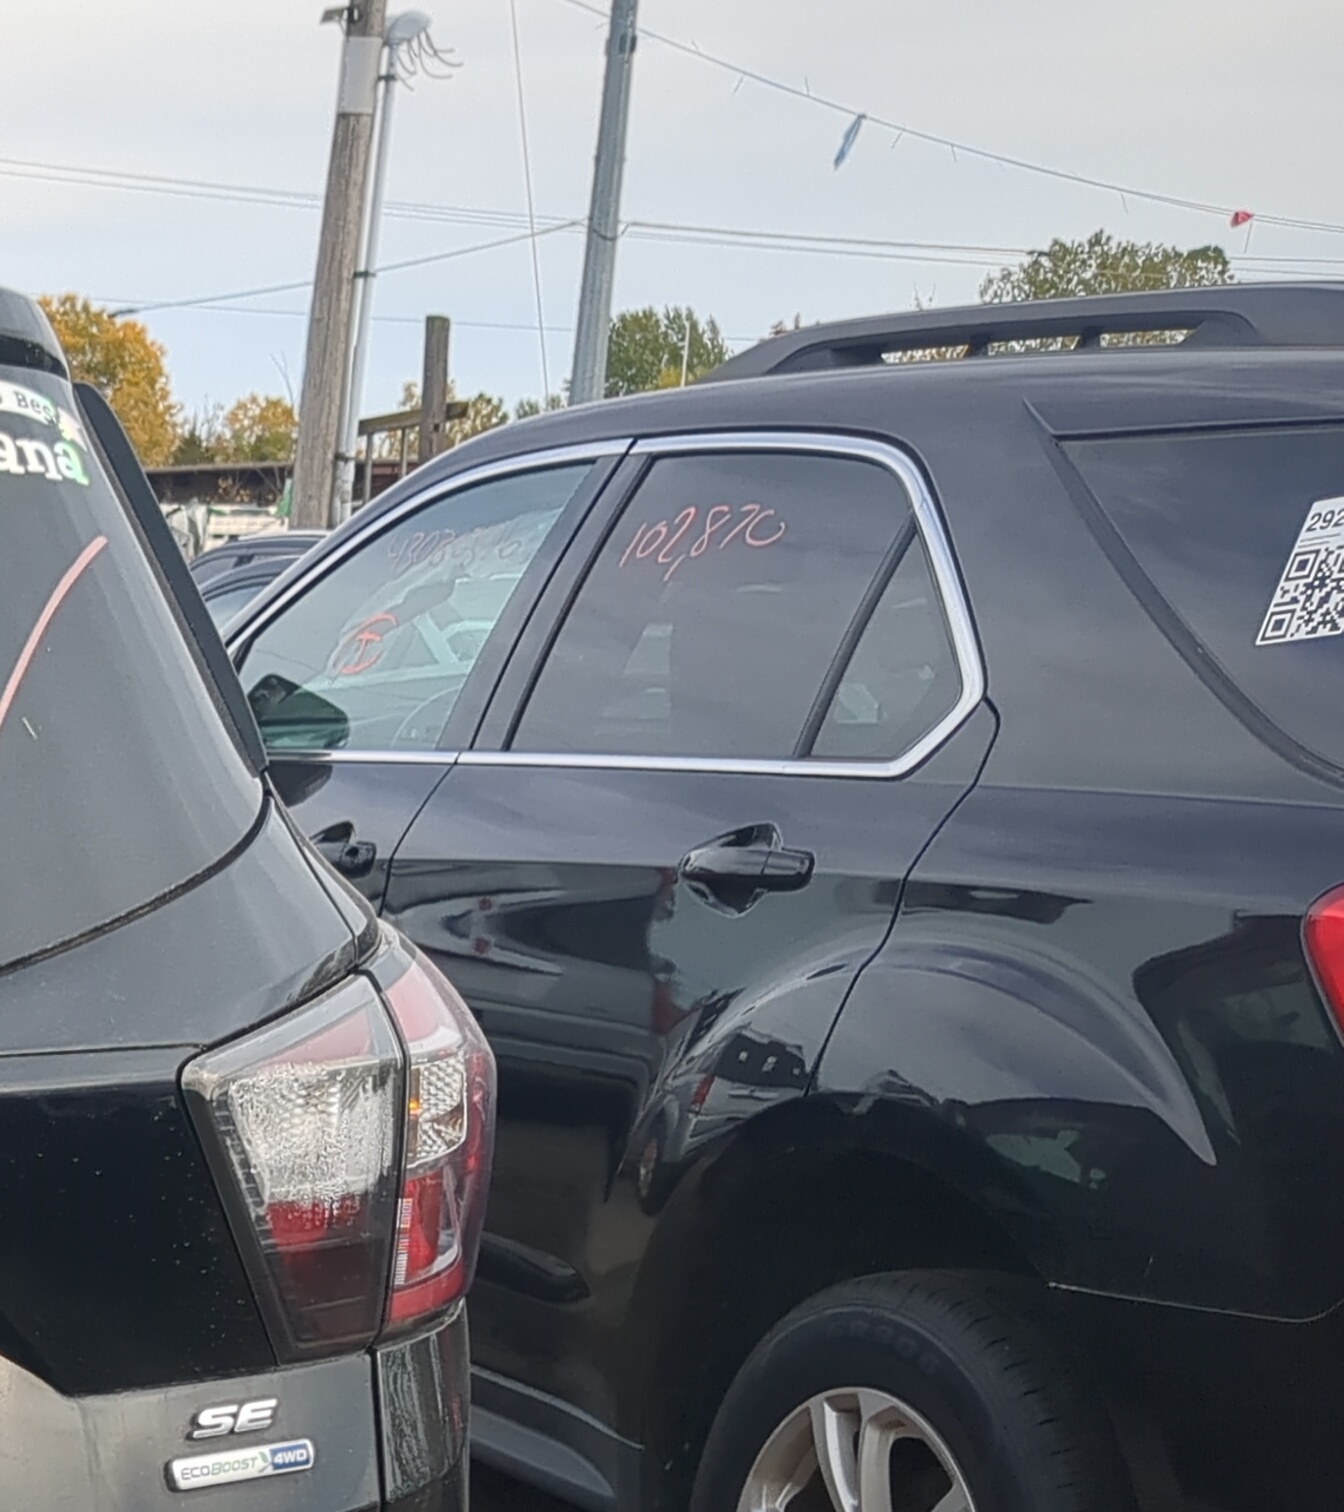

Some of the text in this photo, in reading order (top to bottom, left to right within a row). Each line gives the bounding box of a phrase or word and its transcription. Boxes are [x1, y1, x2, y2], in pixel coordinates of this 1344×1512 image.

[192, 1398, 278, 1440] SE
[180, 1451, 308, 1481] ECOBOOST 4WD
